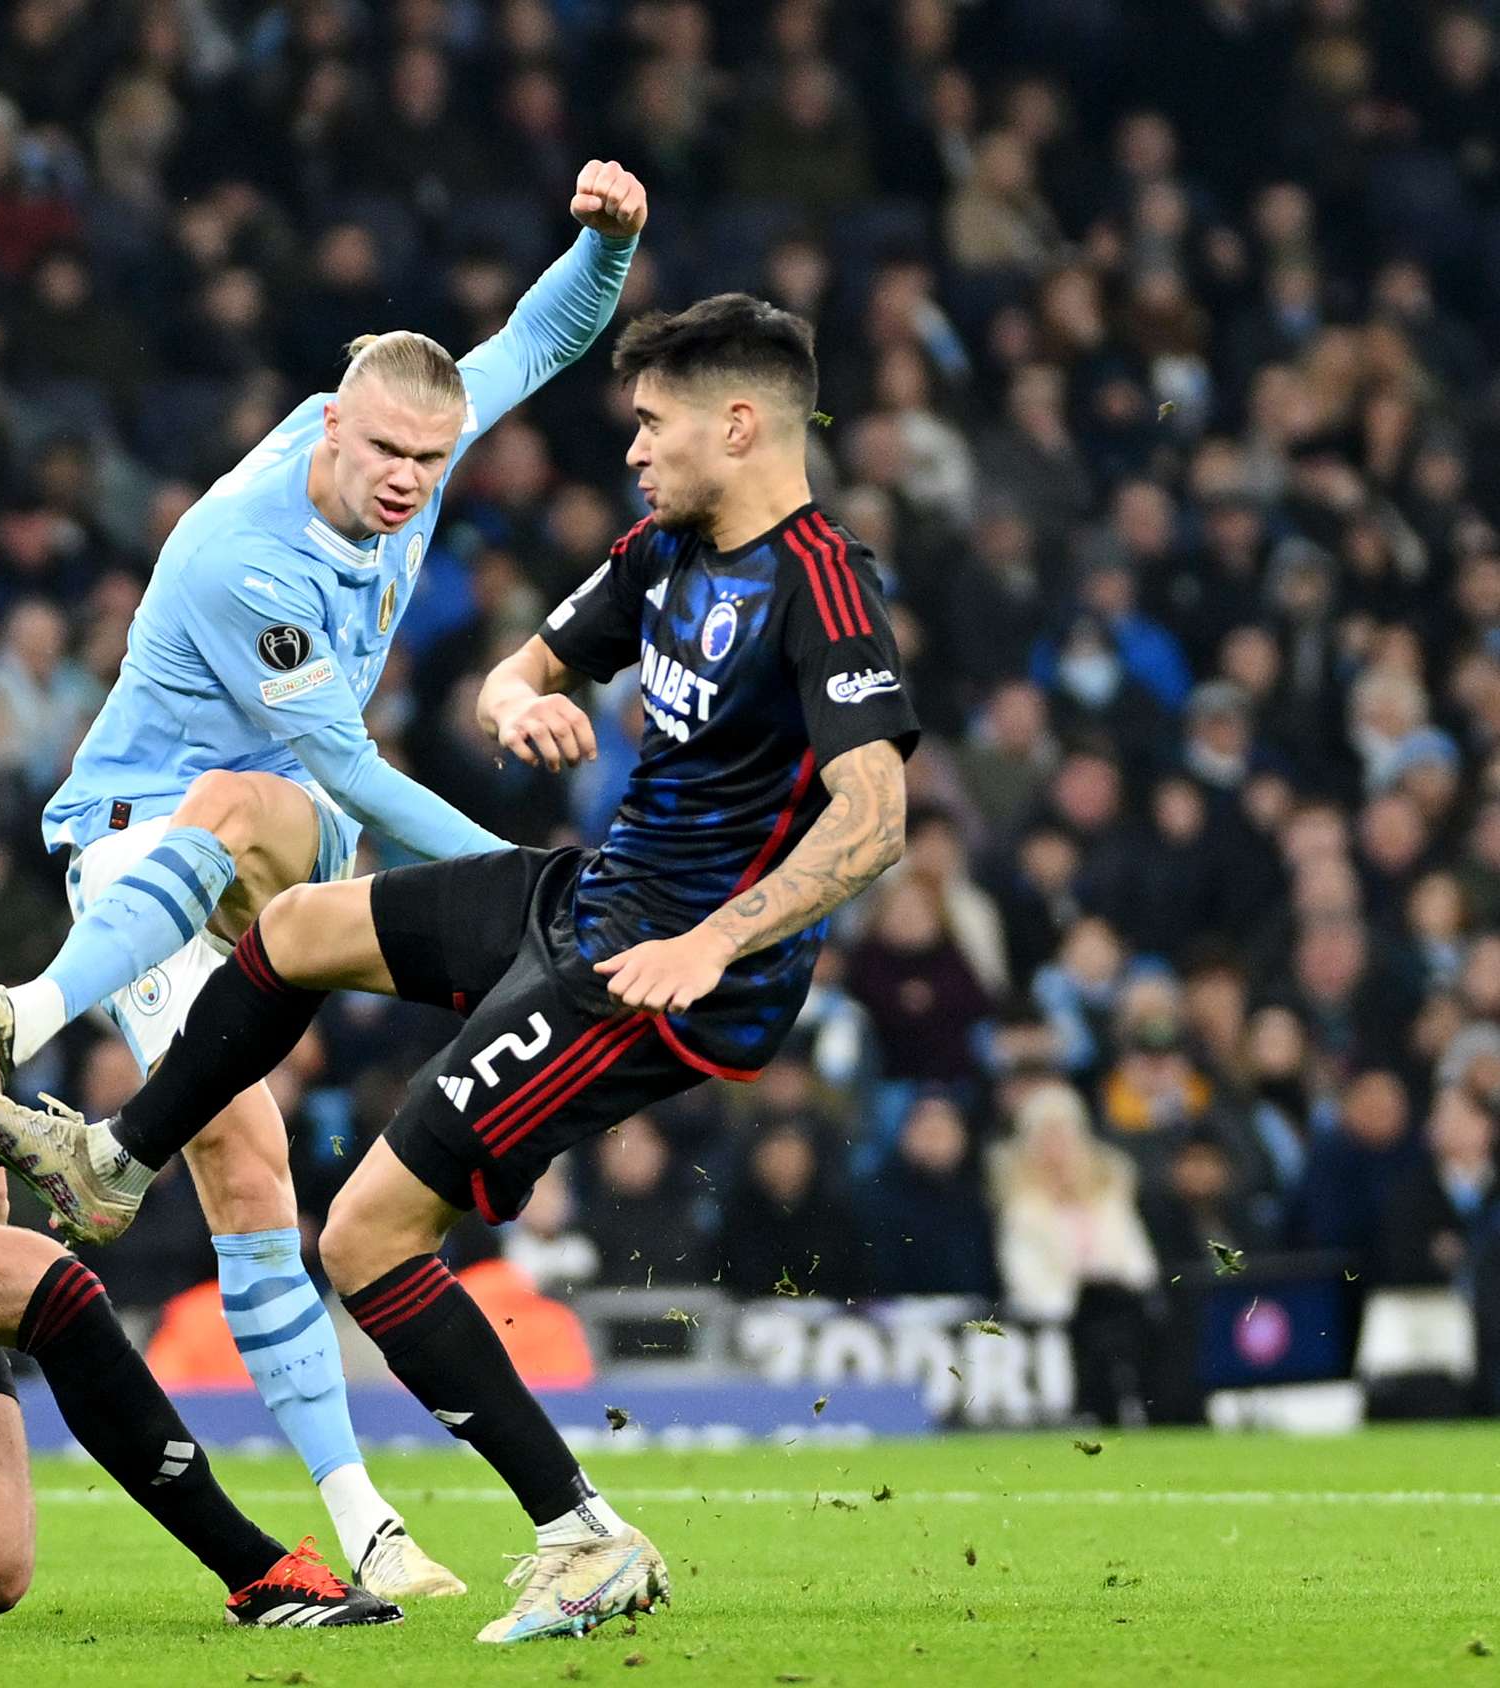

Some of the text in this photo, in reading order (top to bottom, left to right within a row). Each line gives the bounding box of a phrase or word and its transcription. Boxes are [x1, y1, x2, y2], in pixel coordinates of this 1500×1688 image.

[263, 665, 332, 695] FOUNDATION
[640, 638, 719, 721] NIBET
[470, 1011, 552, 1088] 2
[270, 1347, 325, 1379] CITY
